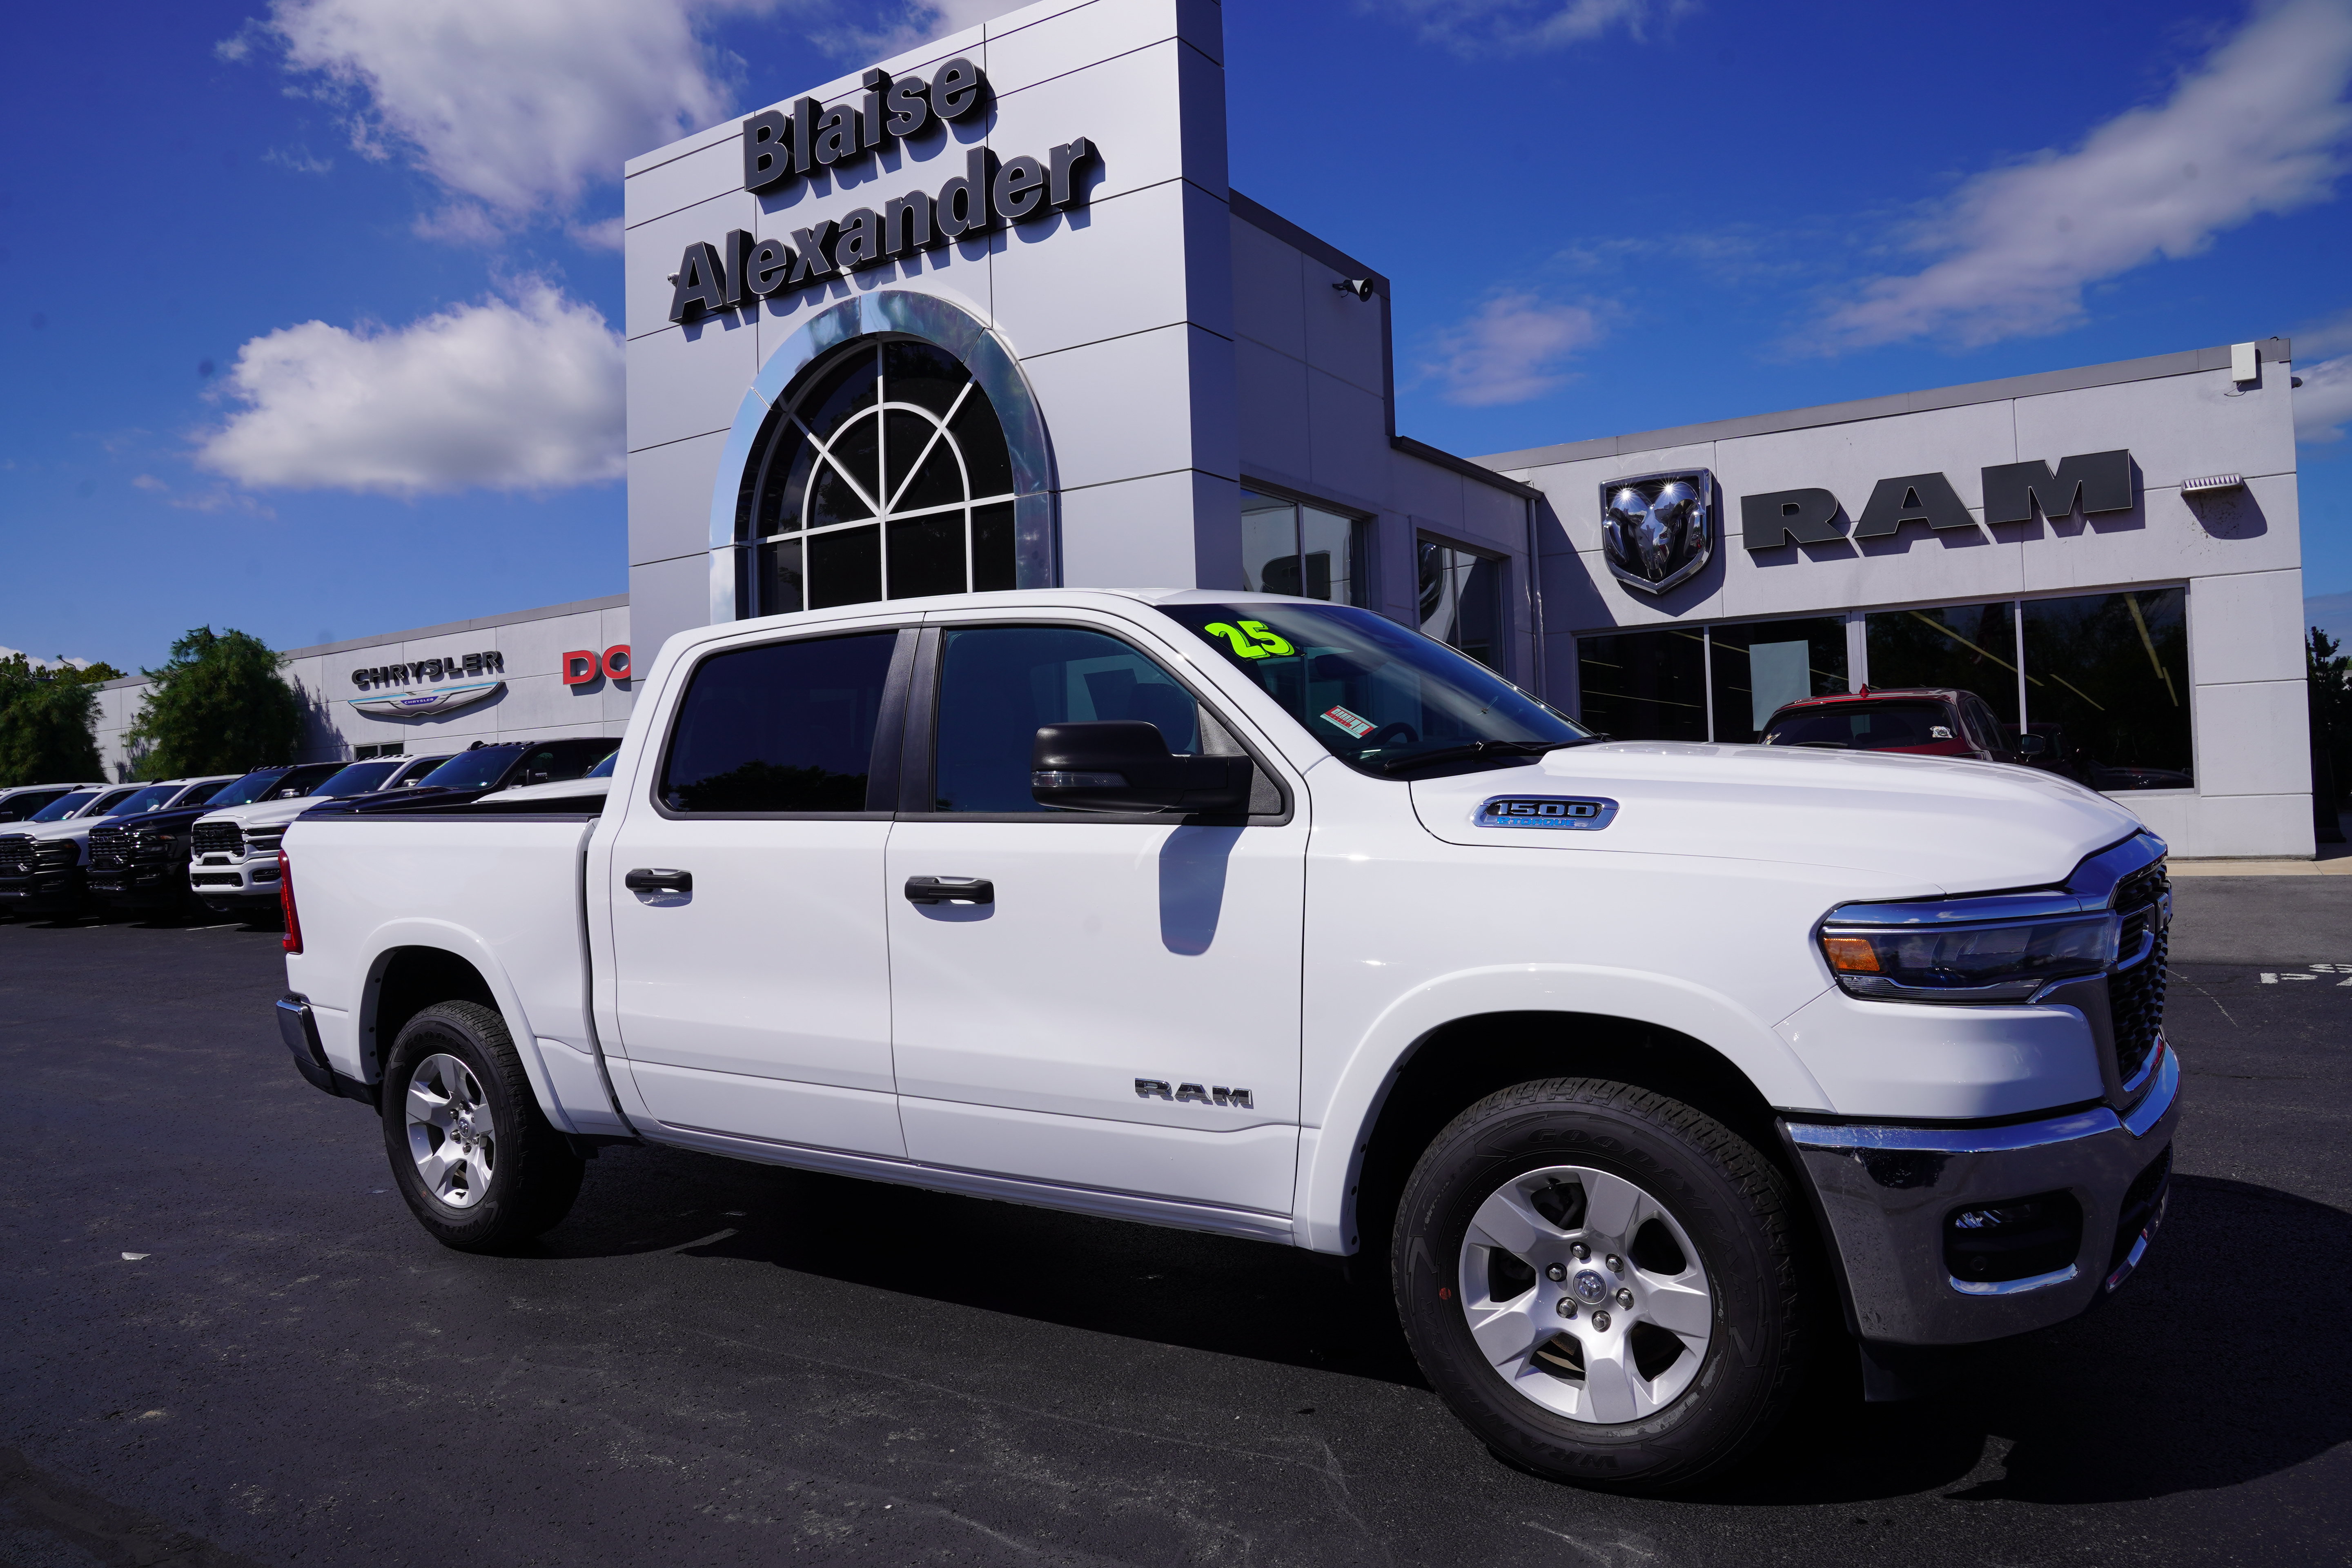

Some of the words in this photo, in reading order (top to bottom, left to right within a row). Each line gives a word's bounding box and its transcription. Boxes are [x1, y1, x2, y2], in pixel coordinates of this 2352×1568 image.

[743, 57, 985, 194] Blaise
[668, 136, 1098, 324] Alexander
[1741, 449, 2132, 550] RAM
[351, 650, 502, 686] CHRYSLER
[562, 644, 631, 685] DO
[1204, 621, 1295, 659] 25
[1496, 802, 1596, 816] 1500
[1135, 1078, 1252, 1106] RAM
[1527, 1127, 1752, 1307] GOODYEAR
[1418, 1297, 1621, 1470] WRANGLER
